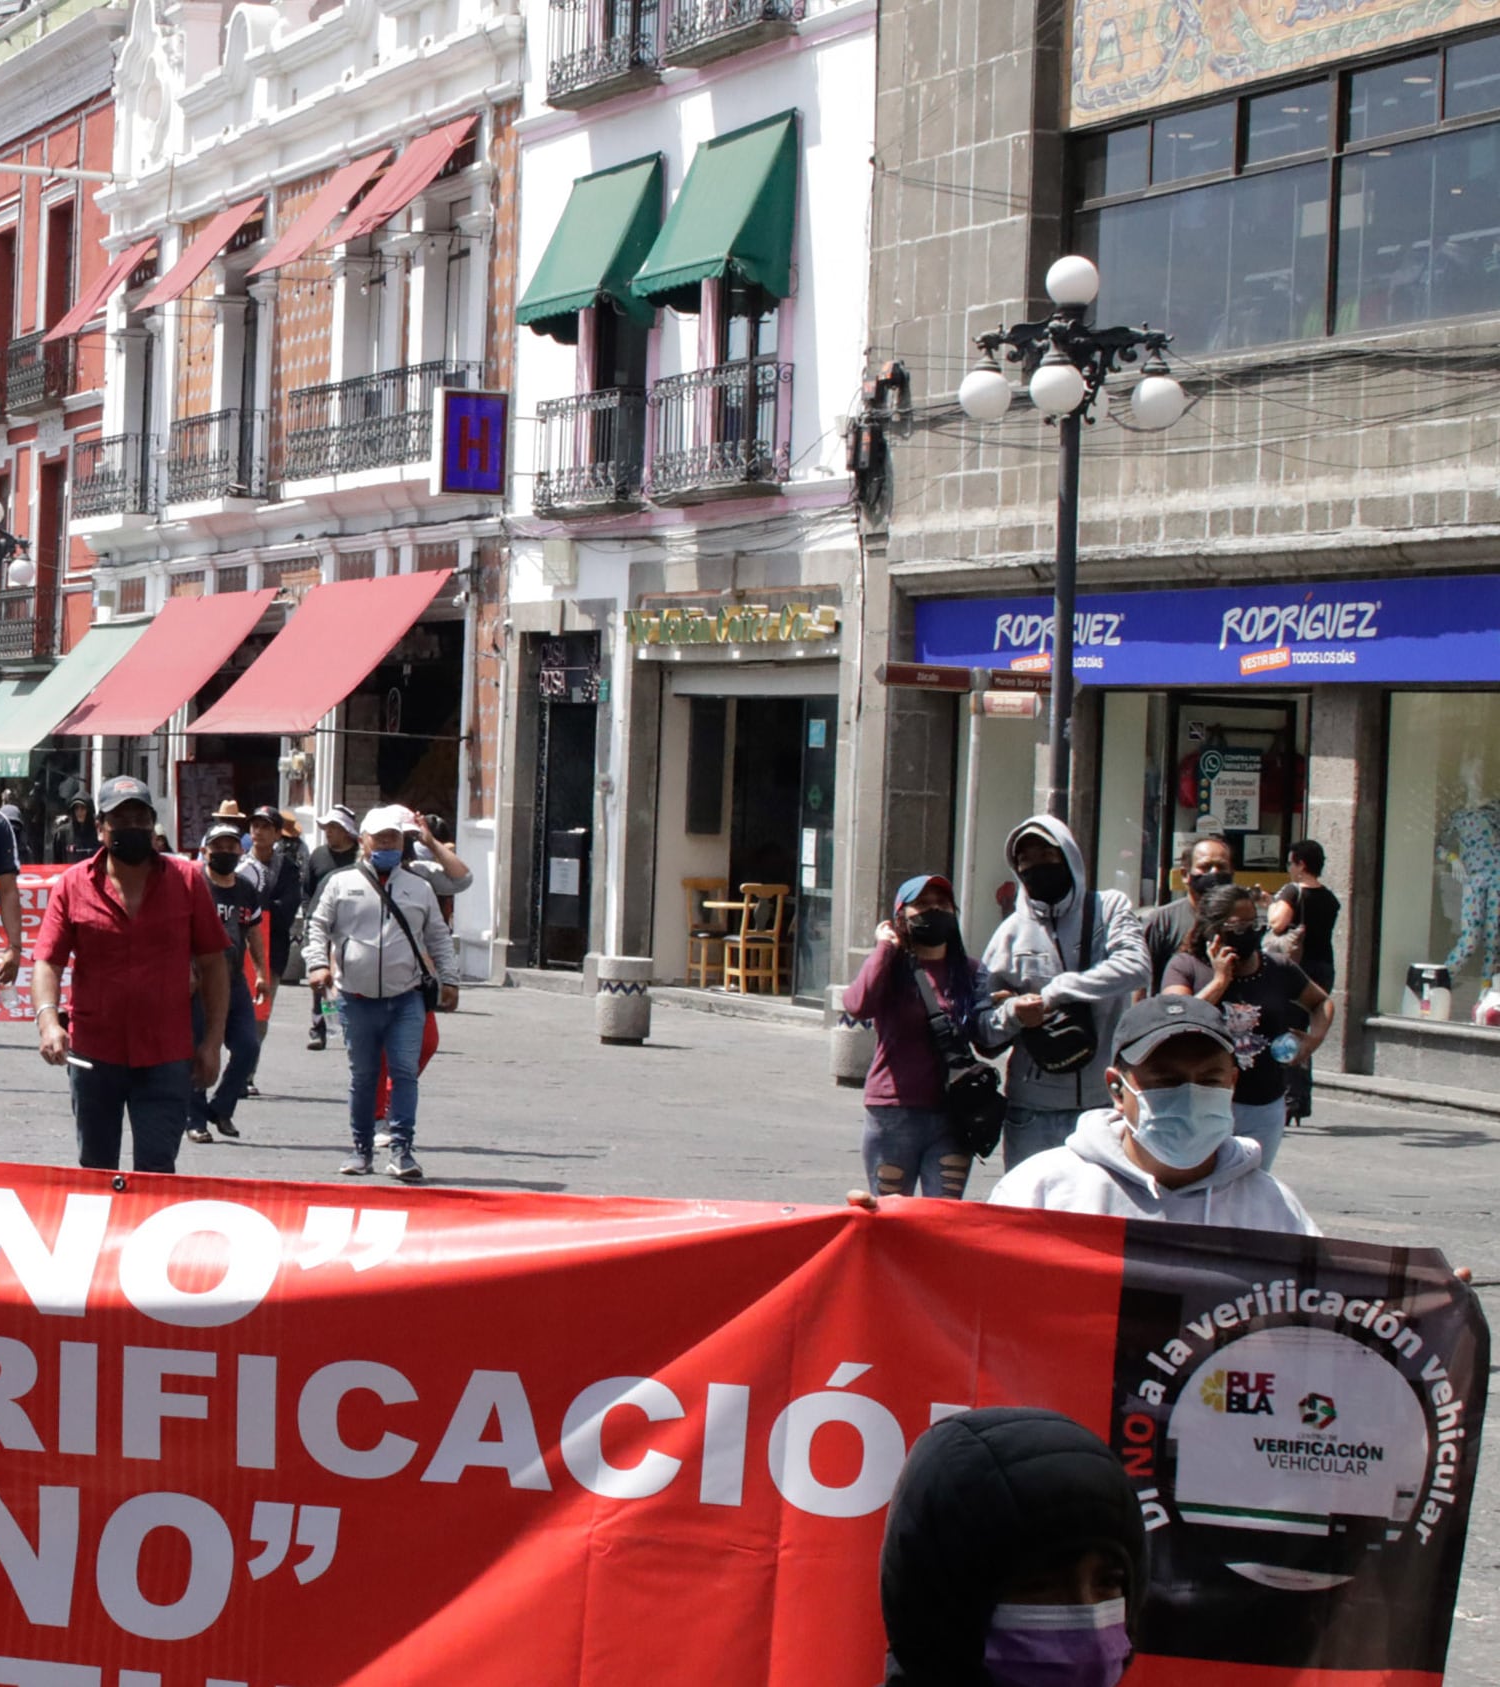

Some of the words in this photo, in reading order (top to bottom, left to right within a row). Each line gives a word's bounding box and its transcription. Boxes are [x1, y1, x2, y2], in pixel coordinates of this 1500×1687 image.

[458, 415, 490, 473] H
[716, 604, 774, 642] Coffee
[993, 613, 1121, 654] RODRUEZ
[1219, 592, 1378, 651] RODRÍGUEZ
[1241, 655, 1269, 670] VESTIR
[1269, 652, 1287, 666] BIEN
[1292, 652, 1319, 664] TODOS
[1320, 652, 1335, 664] LOS
[1336, 649, 1356, 664] DÍAS
[540, 670, 565, 697] ROSA
[1224, 762, 1262, 770] WHATSAPP
[1186, 1279, 1423, 1359] verificación
[1146, 1337, 1193, 1376] la
[1138, 1378, 1166, 1407] a
[1226, 1371, 1276, 1394] PUE
[1226, 1391, 1274, 1416] BLA
[1123, 1412, 1156, 1478] NO
[1253, 1437, 1384, 1461] VERIFICACIÓN
[1420, 1354, 1466, 1546] vehicular
[1267, 1454, 1368, 1476] VEHICULAR
